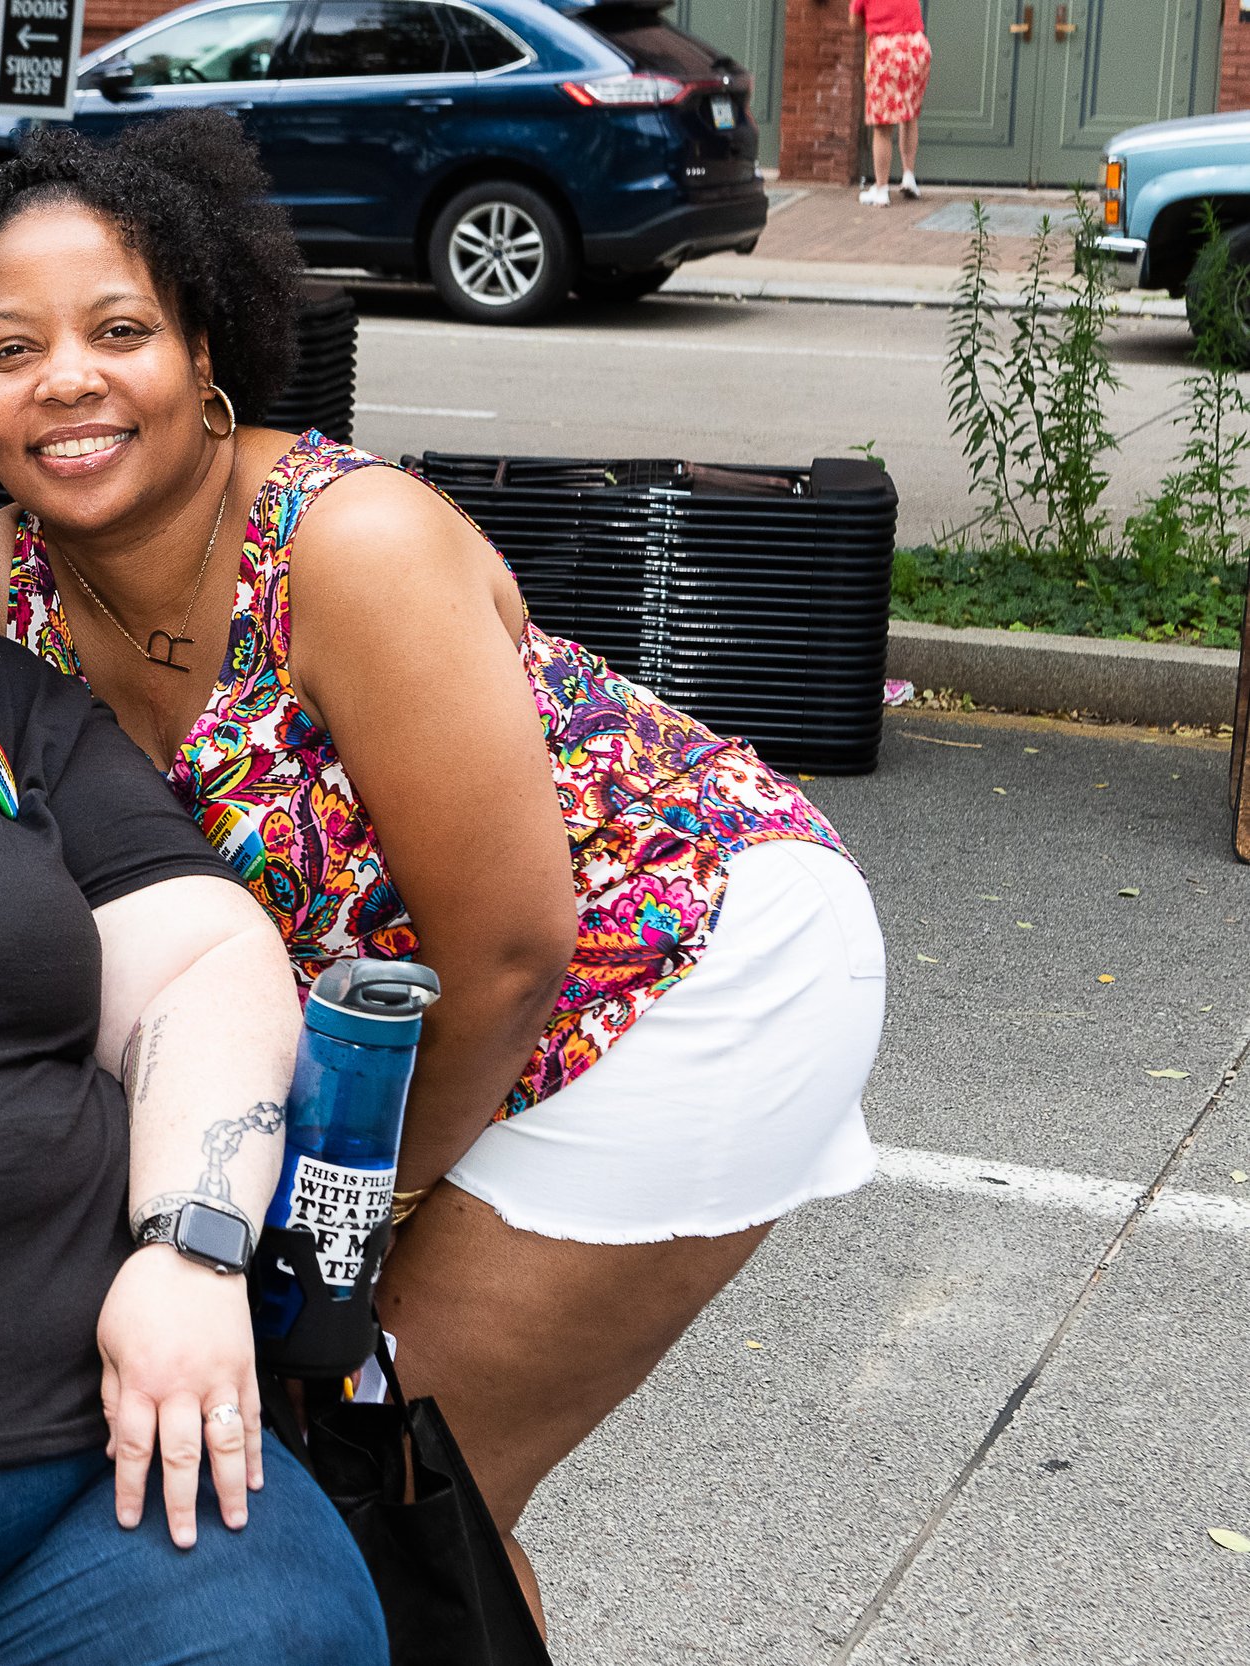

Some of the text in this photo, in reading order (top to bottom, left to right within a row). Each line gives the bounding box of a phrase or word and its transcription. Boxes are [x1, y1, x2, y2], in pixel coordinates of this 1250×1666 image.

[10, 0, 68, 19] ROOMS
[6, 55, 63, 77] ROOMS
[13, 76, 51, 95] REST
[213, 827, 232, 852] IGHTS
[227, 842, 245, 866] UMAN
[303, 1163, 339, 1182] THIS
[343, 1174, 358, 1186] IS
[300, 1177, 362, 1205] WITH
